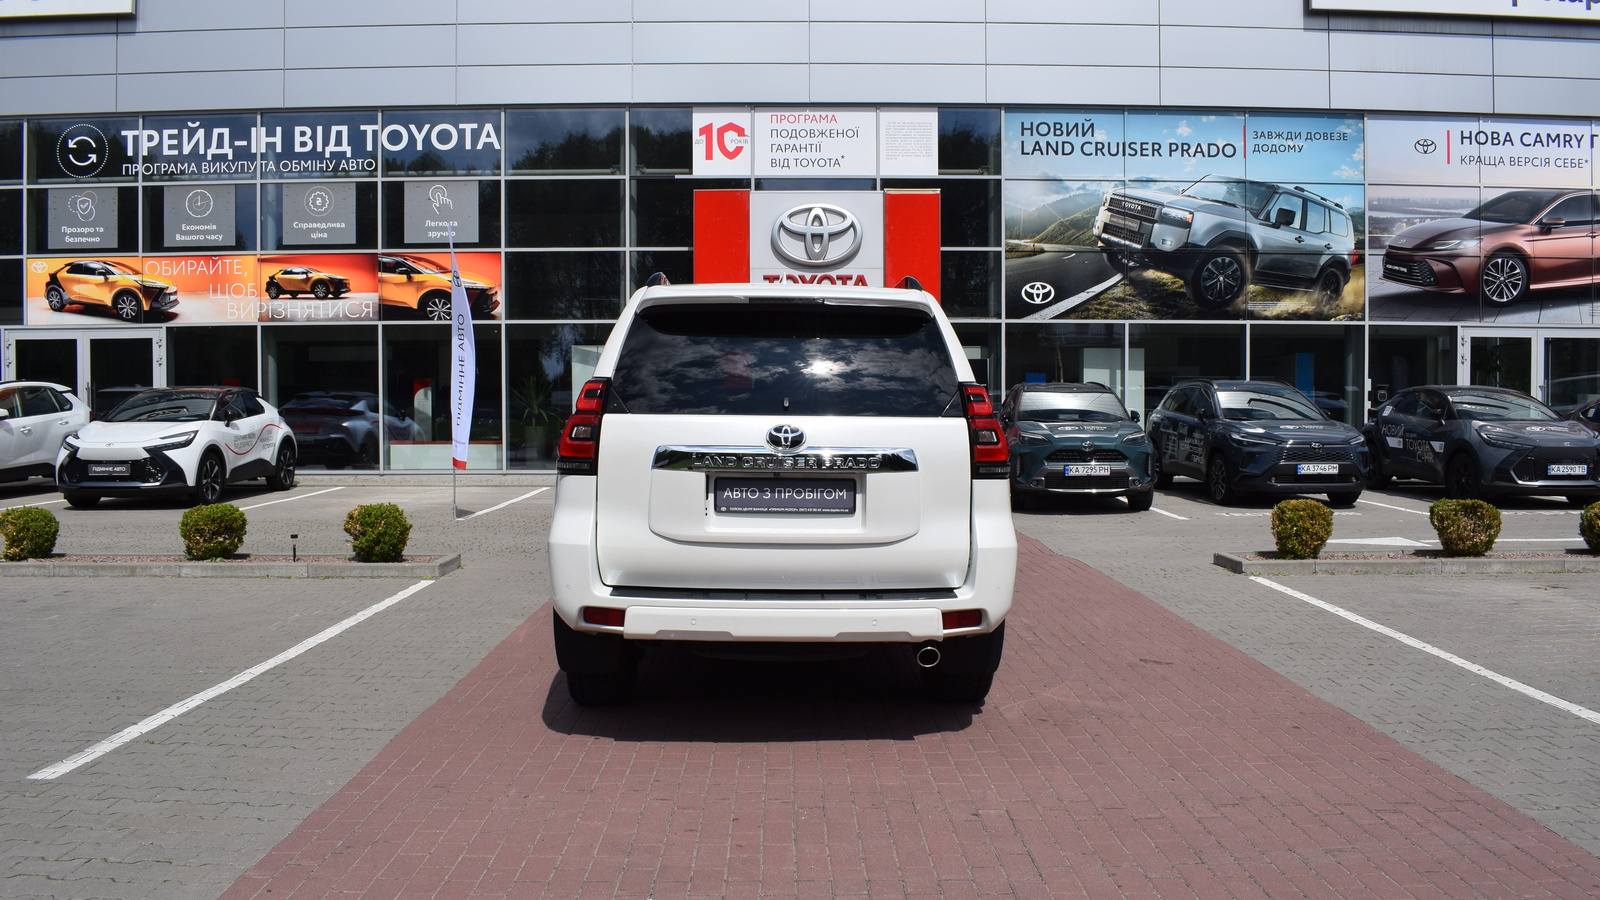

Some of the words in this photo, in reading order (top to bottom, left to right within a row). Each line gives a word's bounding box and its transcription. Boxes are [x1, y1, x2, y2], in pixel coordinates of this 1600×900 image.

[770, 114, 838, 124] ПРОГРАМА
[770, 126, 860, 140] ПОДОВЖЕНОЇ
[1020, 118, 1095, 137] НОВИЙ
[120, 121, 282, 161] ТРЕЙД-ІН
[294, 125, 352, 158] ВІД
[359, 123, 501, 151] TOYOTA
[1252, 130, 1302, 141] ЗАВЖДИ
[1304, 131, 1349, 142] ДОВЕЗЕ
[1460, 130, 1515, 146] НОВА
[1519, 132, 1585, 149] CAMRY
[770, 141, 823, 153] ГАРАНТІЇ
[1020, 140, 1075, 156] LAND
[1080, 141, 1163, 158] CRUISER
[1168, 142, 1237, 158] PRADO
[1252, 143, 1304, 154] ДОДОМУ
[122, 161, 198, 175] ПРОГРАМА
[201, 161, 258, 174] ВИКУПУ
[259, 160, 276, 173] ТА
[279, 159, 336, 172] ОБМІНУ
[338, 158, 376, 171] АВТО
[770, 158, 791, 169] ВІД
[1460, 155, 1506, 168] КРАЩА
[1509, 156, 1551, 168] ВЕРСІЯ
[1121, 201, 1142, 211] TOYOTA
[61, 226, 95, 235] Прозоро
[181, 223, 217, 231] Економія
[293, 221, 346, 230] Справедлива
[64, 235, 100, 243] безпечно
[205, 234, 223, 242] часу
[310, 231, 328, 240] ціна
[145, 257, 248, 277] ОБИРАЙТЕ,
[209, 283, 258, 301] ЩОБ
[227, 300, 373, 319] ВИРІЗНЯТИСЯ
[457, 313, 466, 351] АВТО
[1405, 439, 1431, 452] TOYOTA
[691, 453, 738, 468] LAND
[741, 455, 818, 469] CRUISER
[821, 455, 881, 469] PRADO
[723, 487, 759, 499] АВТО
[775, 487, 847, 500] ПРОБІГОМ
